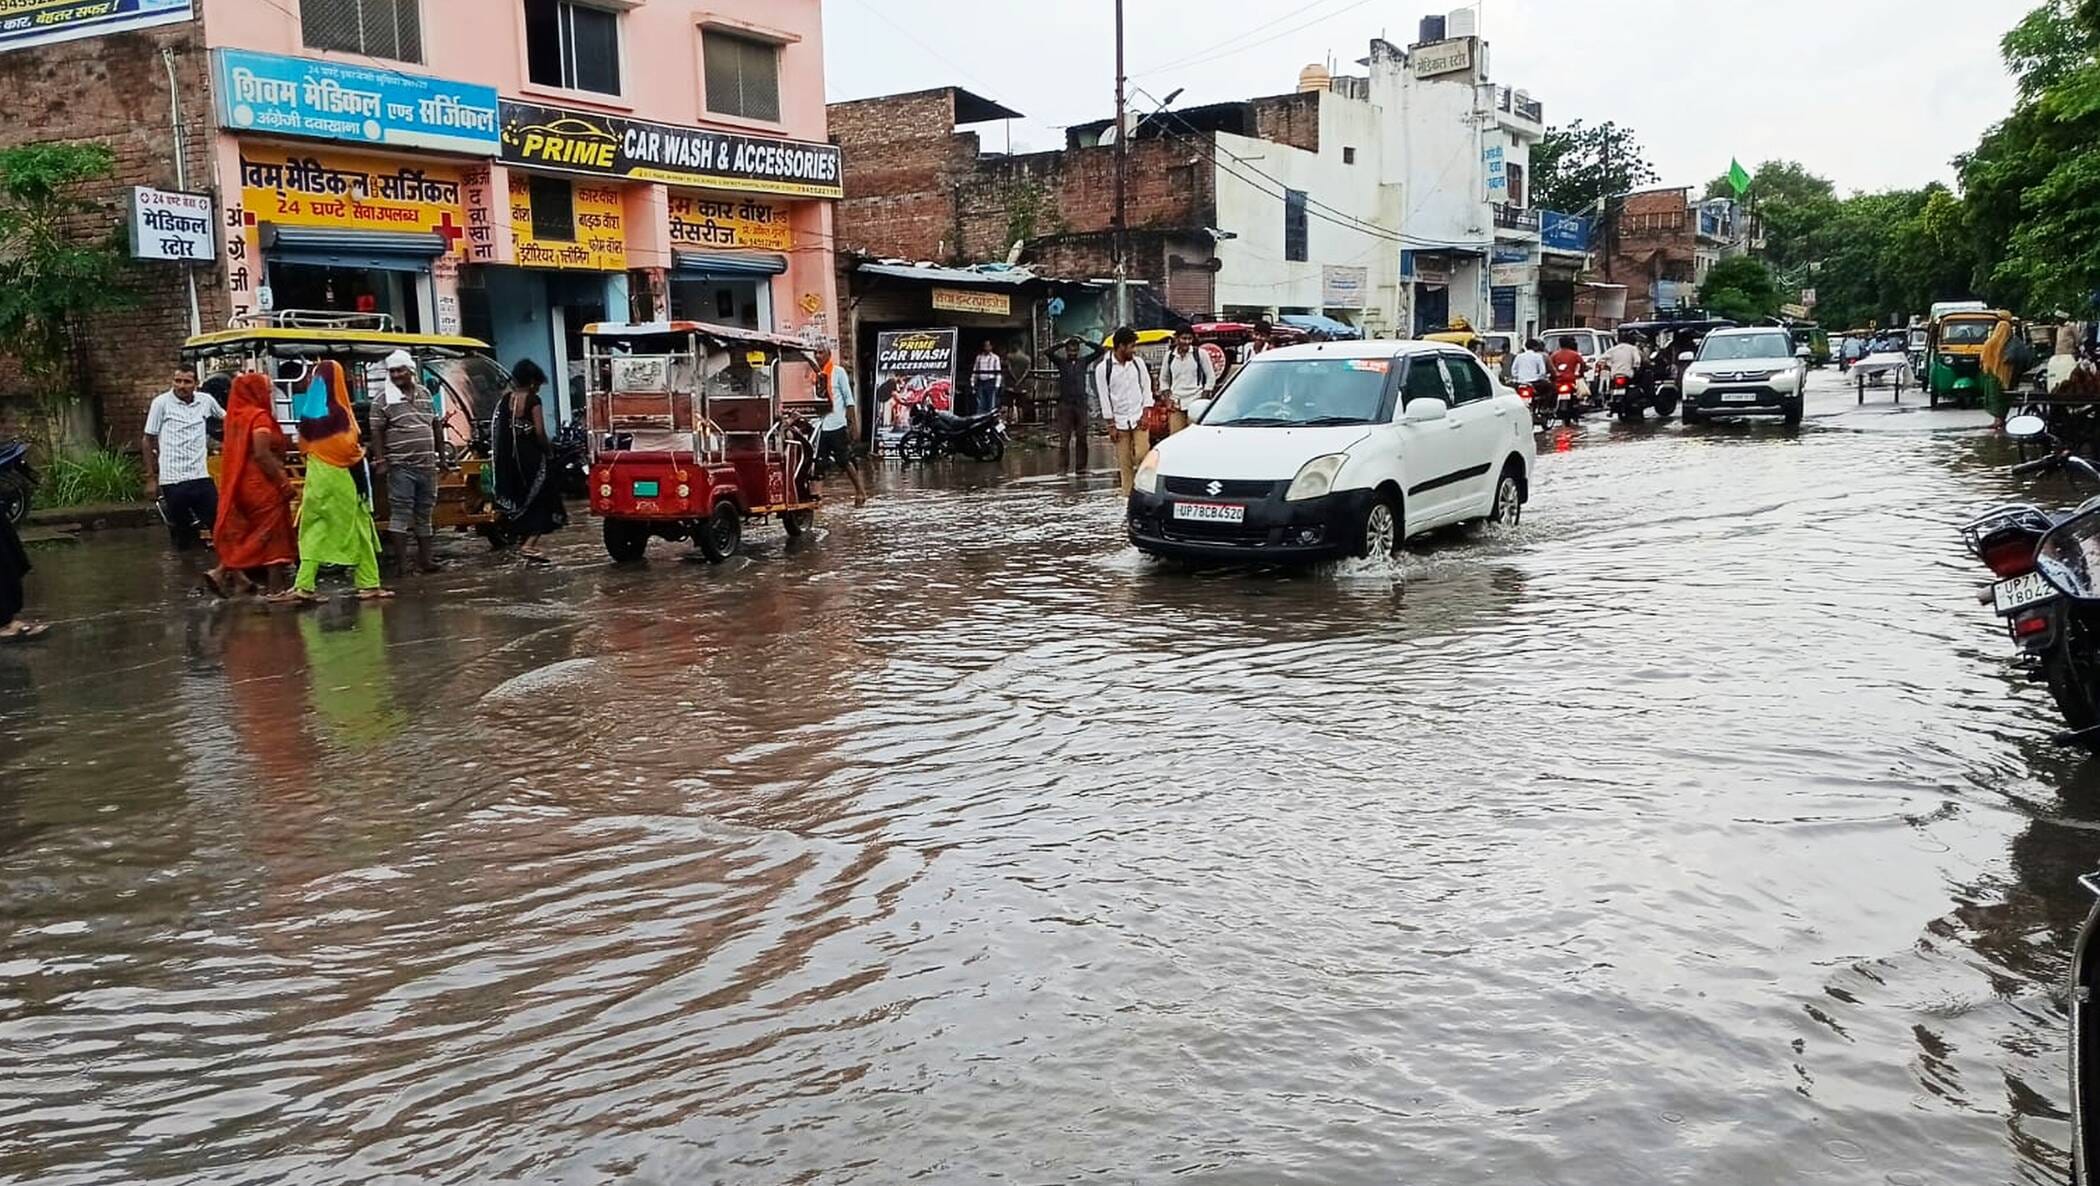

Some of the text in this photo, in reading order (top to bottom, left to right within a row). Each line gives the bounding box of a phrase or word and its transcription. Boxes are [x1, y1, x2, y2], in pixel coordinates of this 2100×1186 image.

[232, 67, 495, 132] शिवम मेडिकल एण्ड सर्जिकल
[256, 108, 361, 135] अंग्रेजी दवाखाना
[522, 133, 618, 168] PRIME
[623, 129, 662, 163] CAR
[663, 133, 712, 170] WASH
[717, 141, 729, 173] &
[733, 142, 837, 181] ACCESSORIES
[153, 193, 164, 204] 24
[378, 168, 459, 205] सर्जिकल
[142, 207, 207, 235] मेडिकल
[278, 199, 419, 223] 24 घण्टे सेवा उपलब्ध
[698, 199, 736, 220] कार
[739, 197, 773, 223] वॉश
[159, 234, 195, 257] स्टोर
[880, 348, 951, 361] CAR WASH
[899, 340, 936, 351] PRIME
[881, 361, 948, 370] & ACCESSORIES
[2005, 572, 2039, 594] UP71
